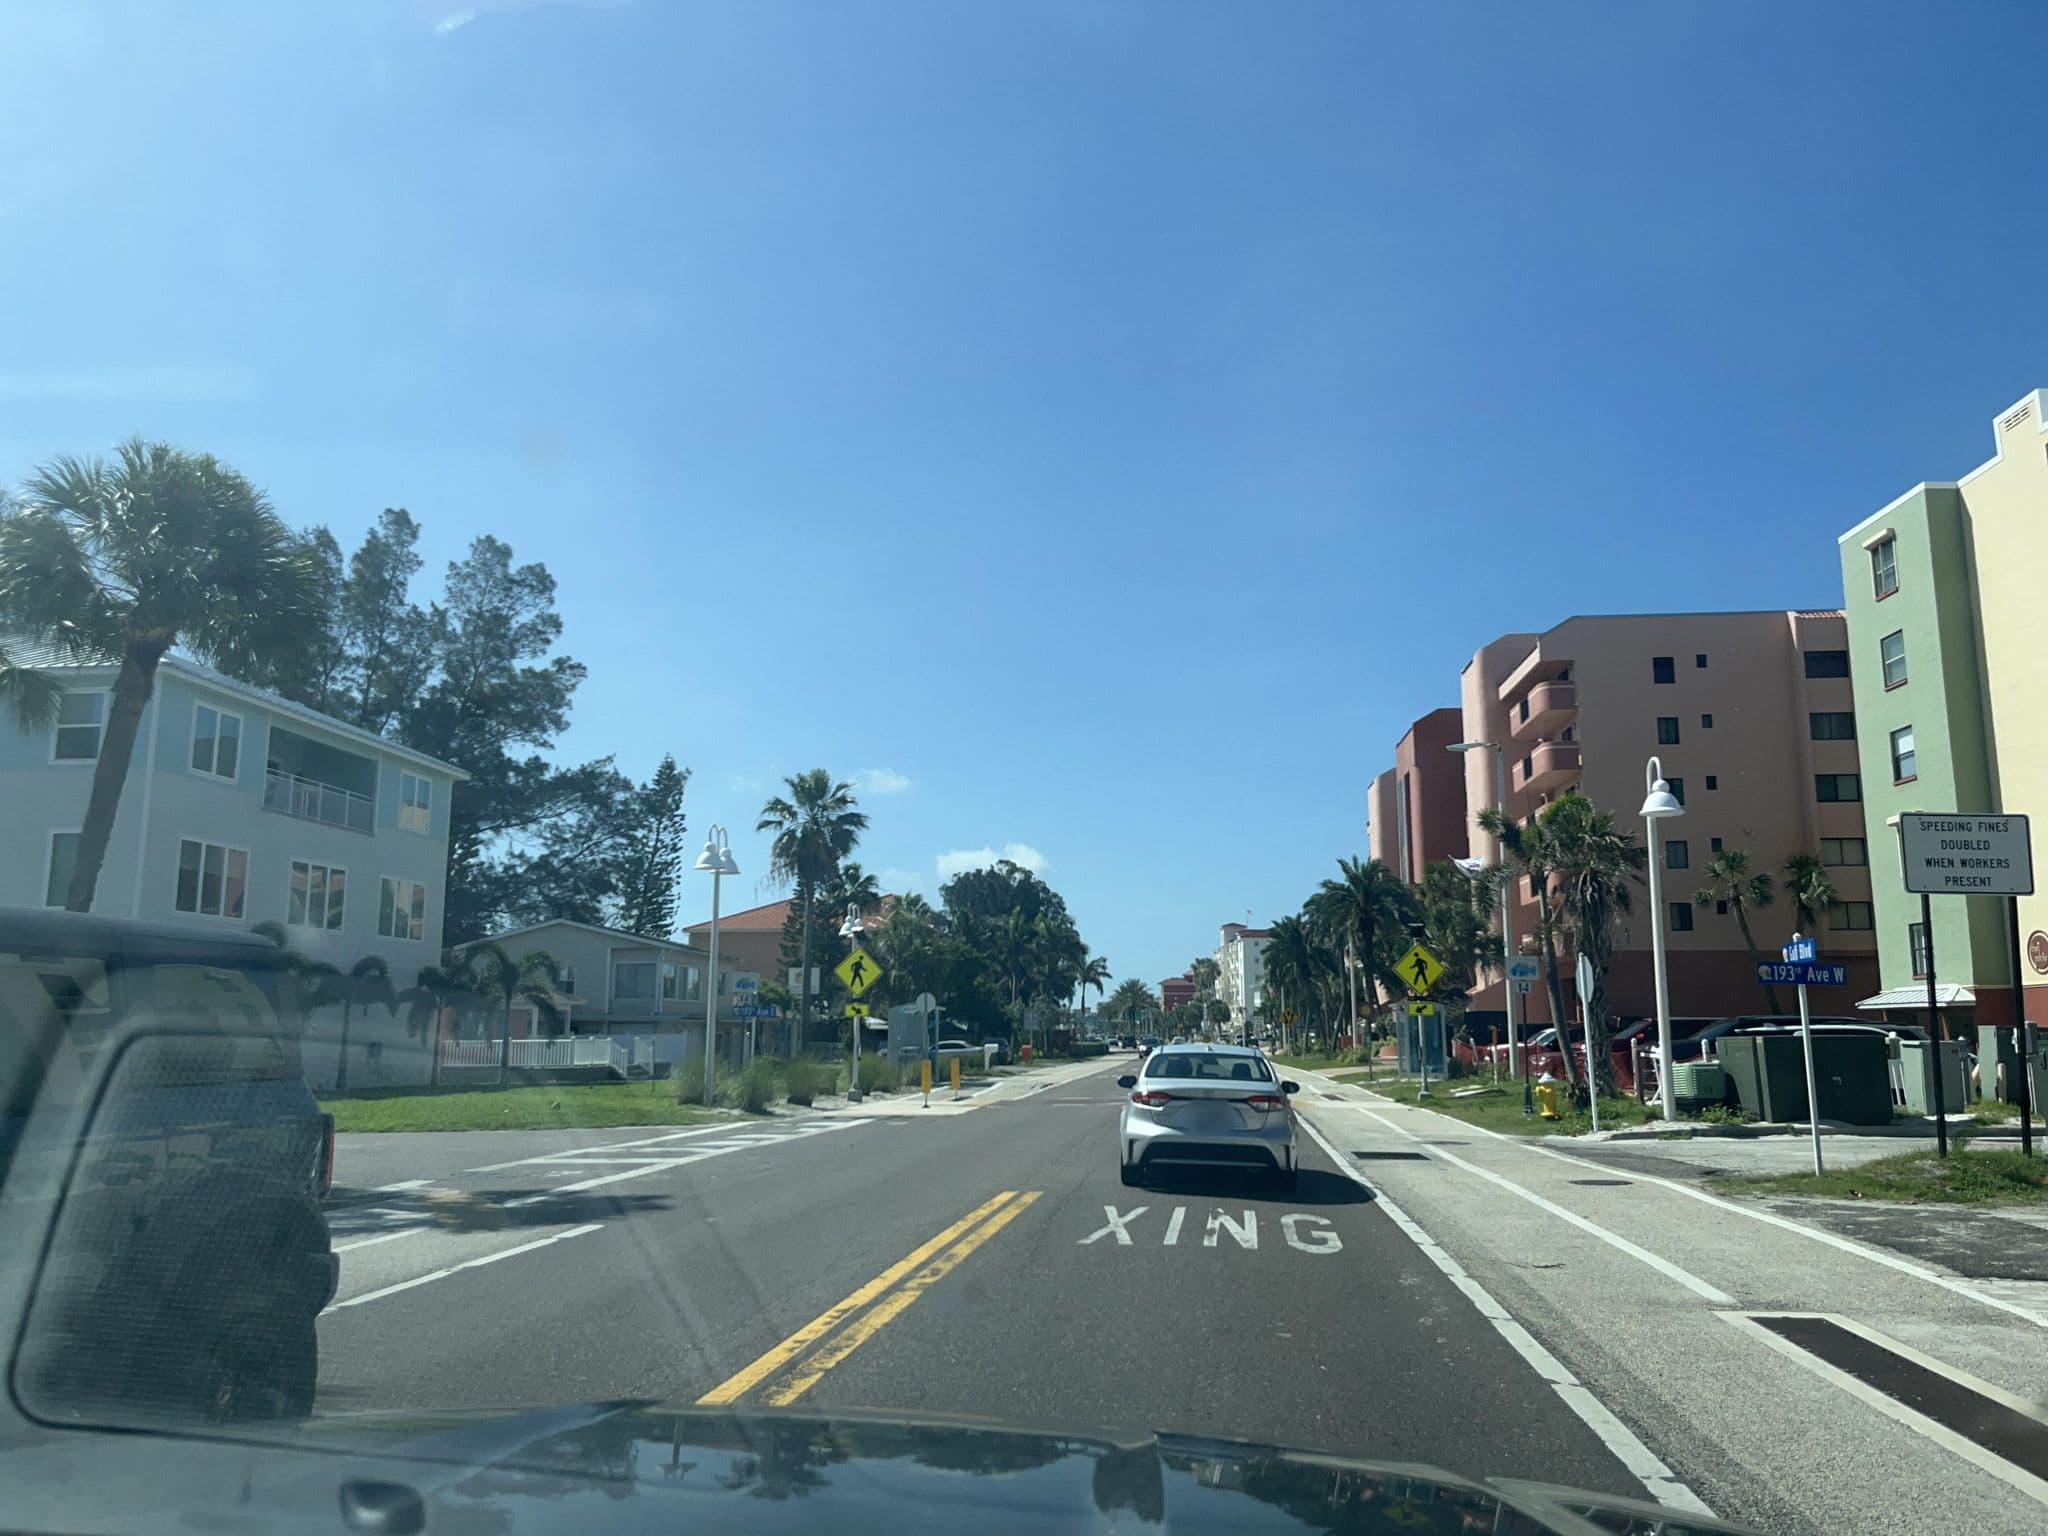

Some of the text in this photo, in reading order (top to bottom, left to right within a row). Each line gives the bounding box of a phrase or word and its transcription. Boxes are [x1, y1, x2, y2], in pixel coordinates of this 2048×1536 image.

[1920, 821, 2009, 833] SPEEDING FINES
[1941, 839, 1990, 851] DOUBLED
[1924, 857, 2010, 869] WHEN WORKERS
[1945, 876, 1992, 887] PRESENT
[1807, 966, 1830, 982] Ave
[1833, 967, 1845, 983] W
[1077, 1205, 1344, 1254] XING
